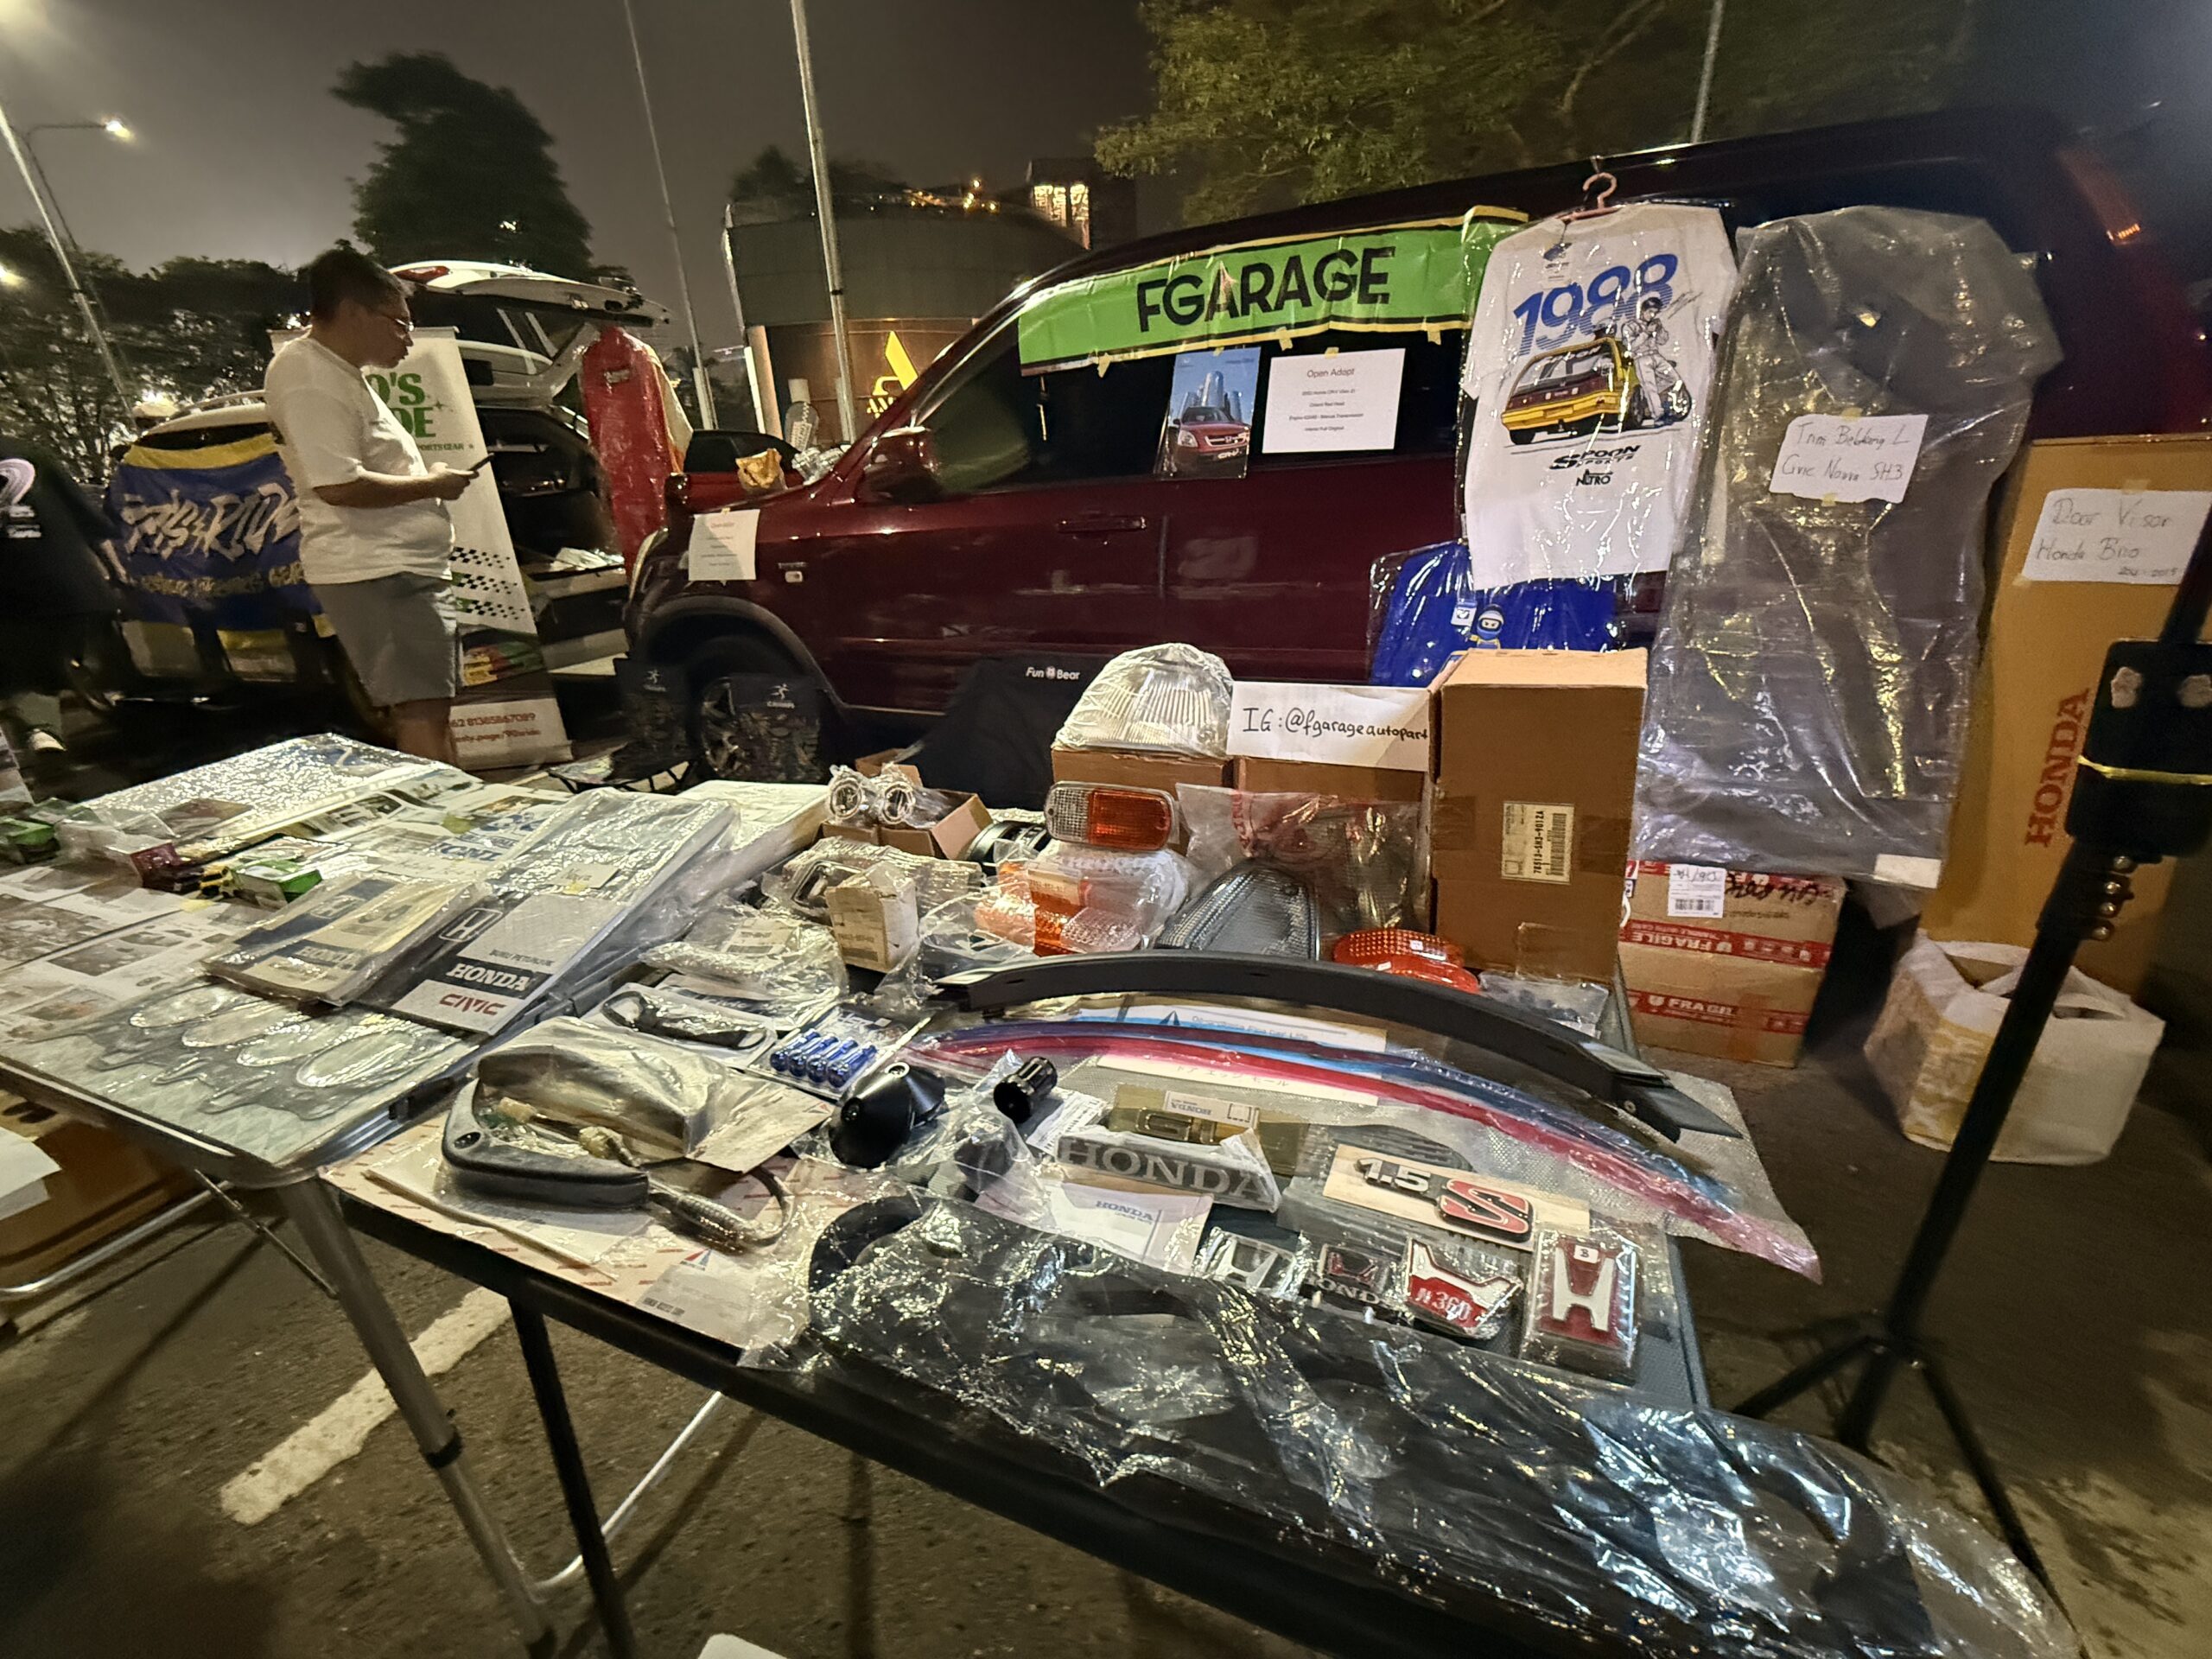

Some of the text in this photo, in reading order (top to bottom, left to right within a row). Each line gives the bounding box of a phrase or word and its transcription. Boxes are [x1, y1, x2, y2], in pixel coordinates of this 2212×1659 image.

[1136, 245, 1396, 333] FGARAGE
[1514, 253, 1678, 356] 1988
[1306, 367, 1355, 378] Open Adopt
[1892, 424, 1911, 446] L
[1549, 445, 1641, 469] SPOON
[1782, 454, 1815, 476] Civic
[2051, 498, 2171, 527] Door Visor
[2036, 538, 2086, 561] Honda
[1026, 666, 1080, 680] Fun Bear
[2024, 687, 2090, 848] HONDA
[1630, 931, 1713, 951] FRAGILE
[446, 963, 531, 992] HONDA
[439, 994, 506, 1016] CIVIC
[1170, 1101, 1212, 1116] HONDA
[1060, 1139, 1271, 1202] HONDA
[1354, 1156, 1432, 1193] 1.5
[1096, 1200, 1154, 1220] HONDA
